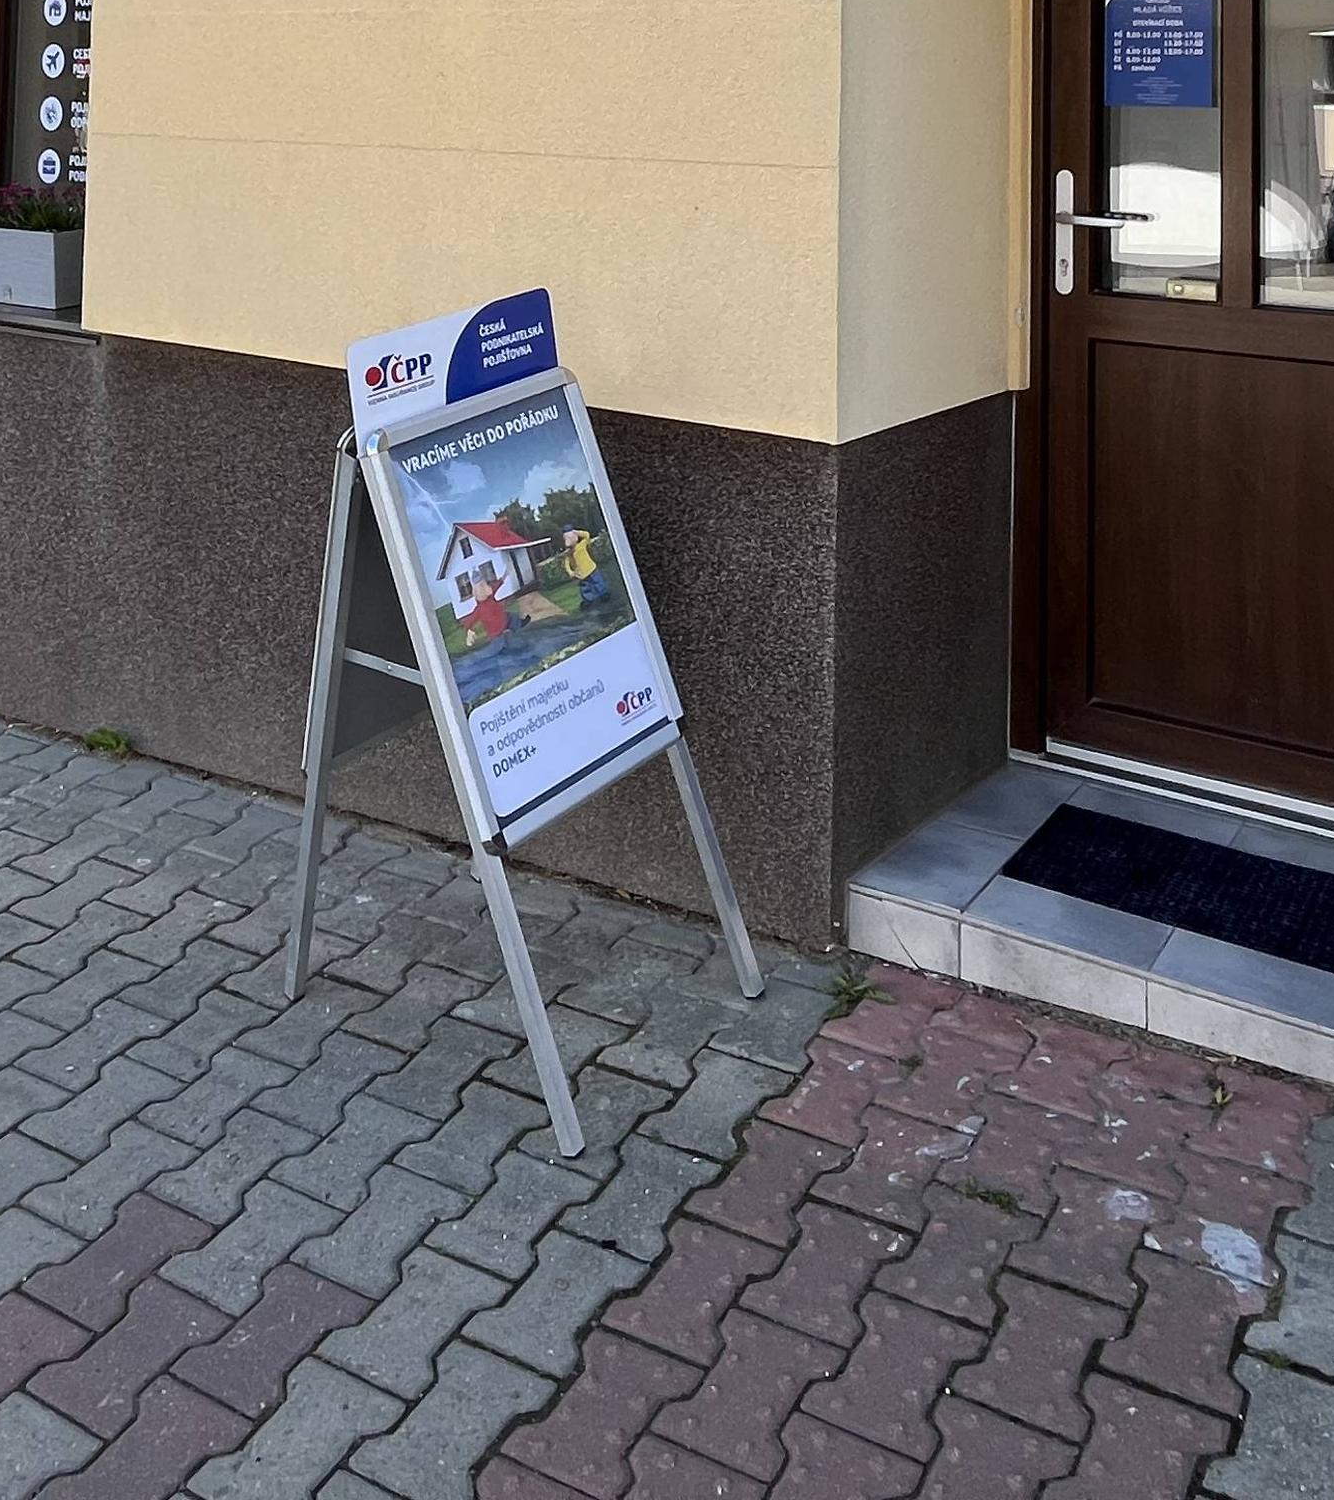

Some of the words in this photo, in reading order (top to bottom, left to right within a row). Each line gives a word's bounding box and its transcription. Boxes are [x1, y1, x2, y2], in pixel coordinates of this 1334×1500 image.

[479, 317, 507, 337] ČESKÁ
[480, 322, 544, 352] PODNIKATELSKÁ
[390, 353, 432, 383] ČPP
[483, 344, 532, 368] POJIŠŤOVNA
[402, 440, 459, 474] VRACÍME
[458, 432, 486, 453] VĚCI
[486, 424, 505, 442] DO
[506, 405, 559, 436] POŘÁDKU
[479, 699, 526, 735] Pojištění
[527, 678, 570, 709] majetku
[630, 686, 653, 710] ČPP
[487, 745, 495, 757] a
[496, 702, 568, 747] odpovědnosti
[568, 679, 605, 710] občanů
[492, 744, 537, 778] DOMEX+
